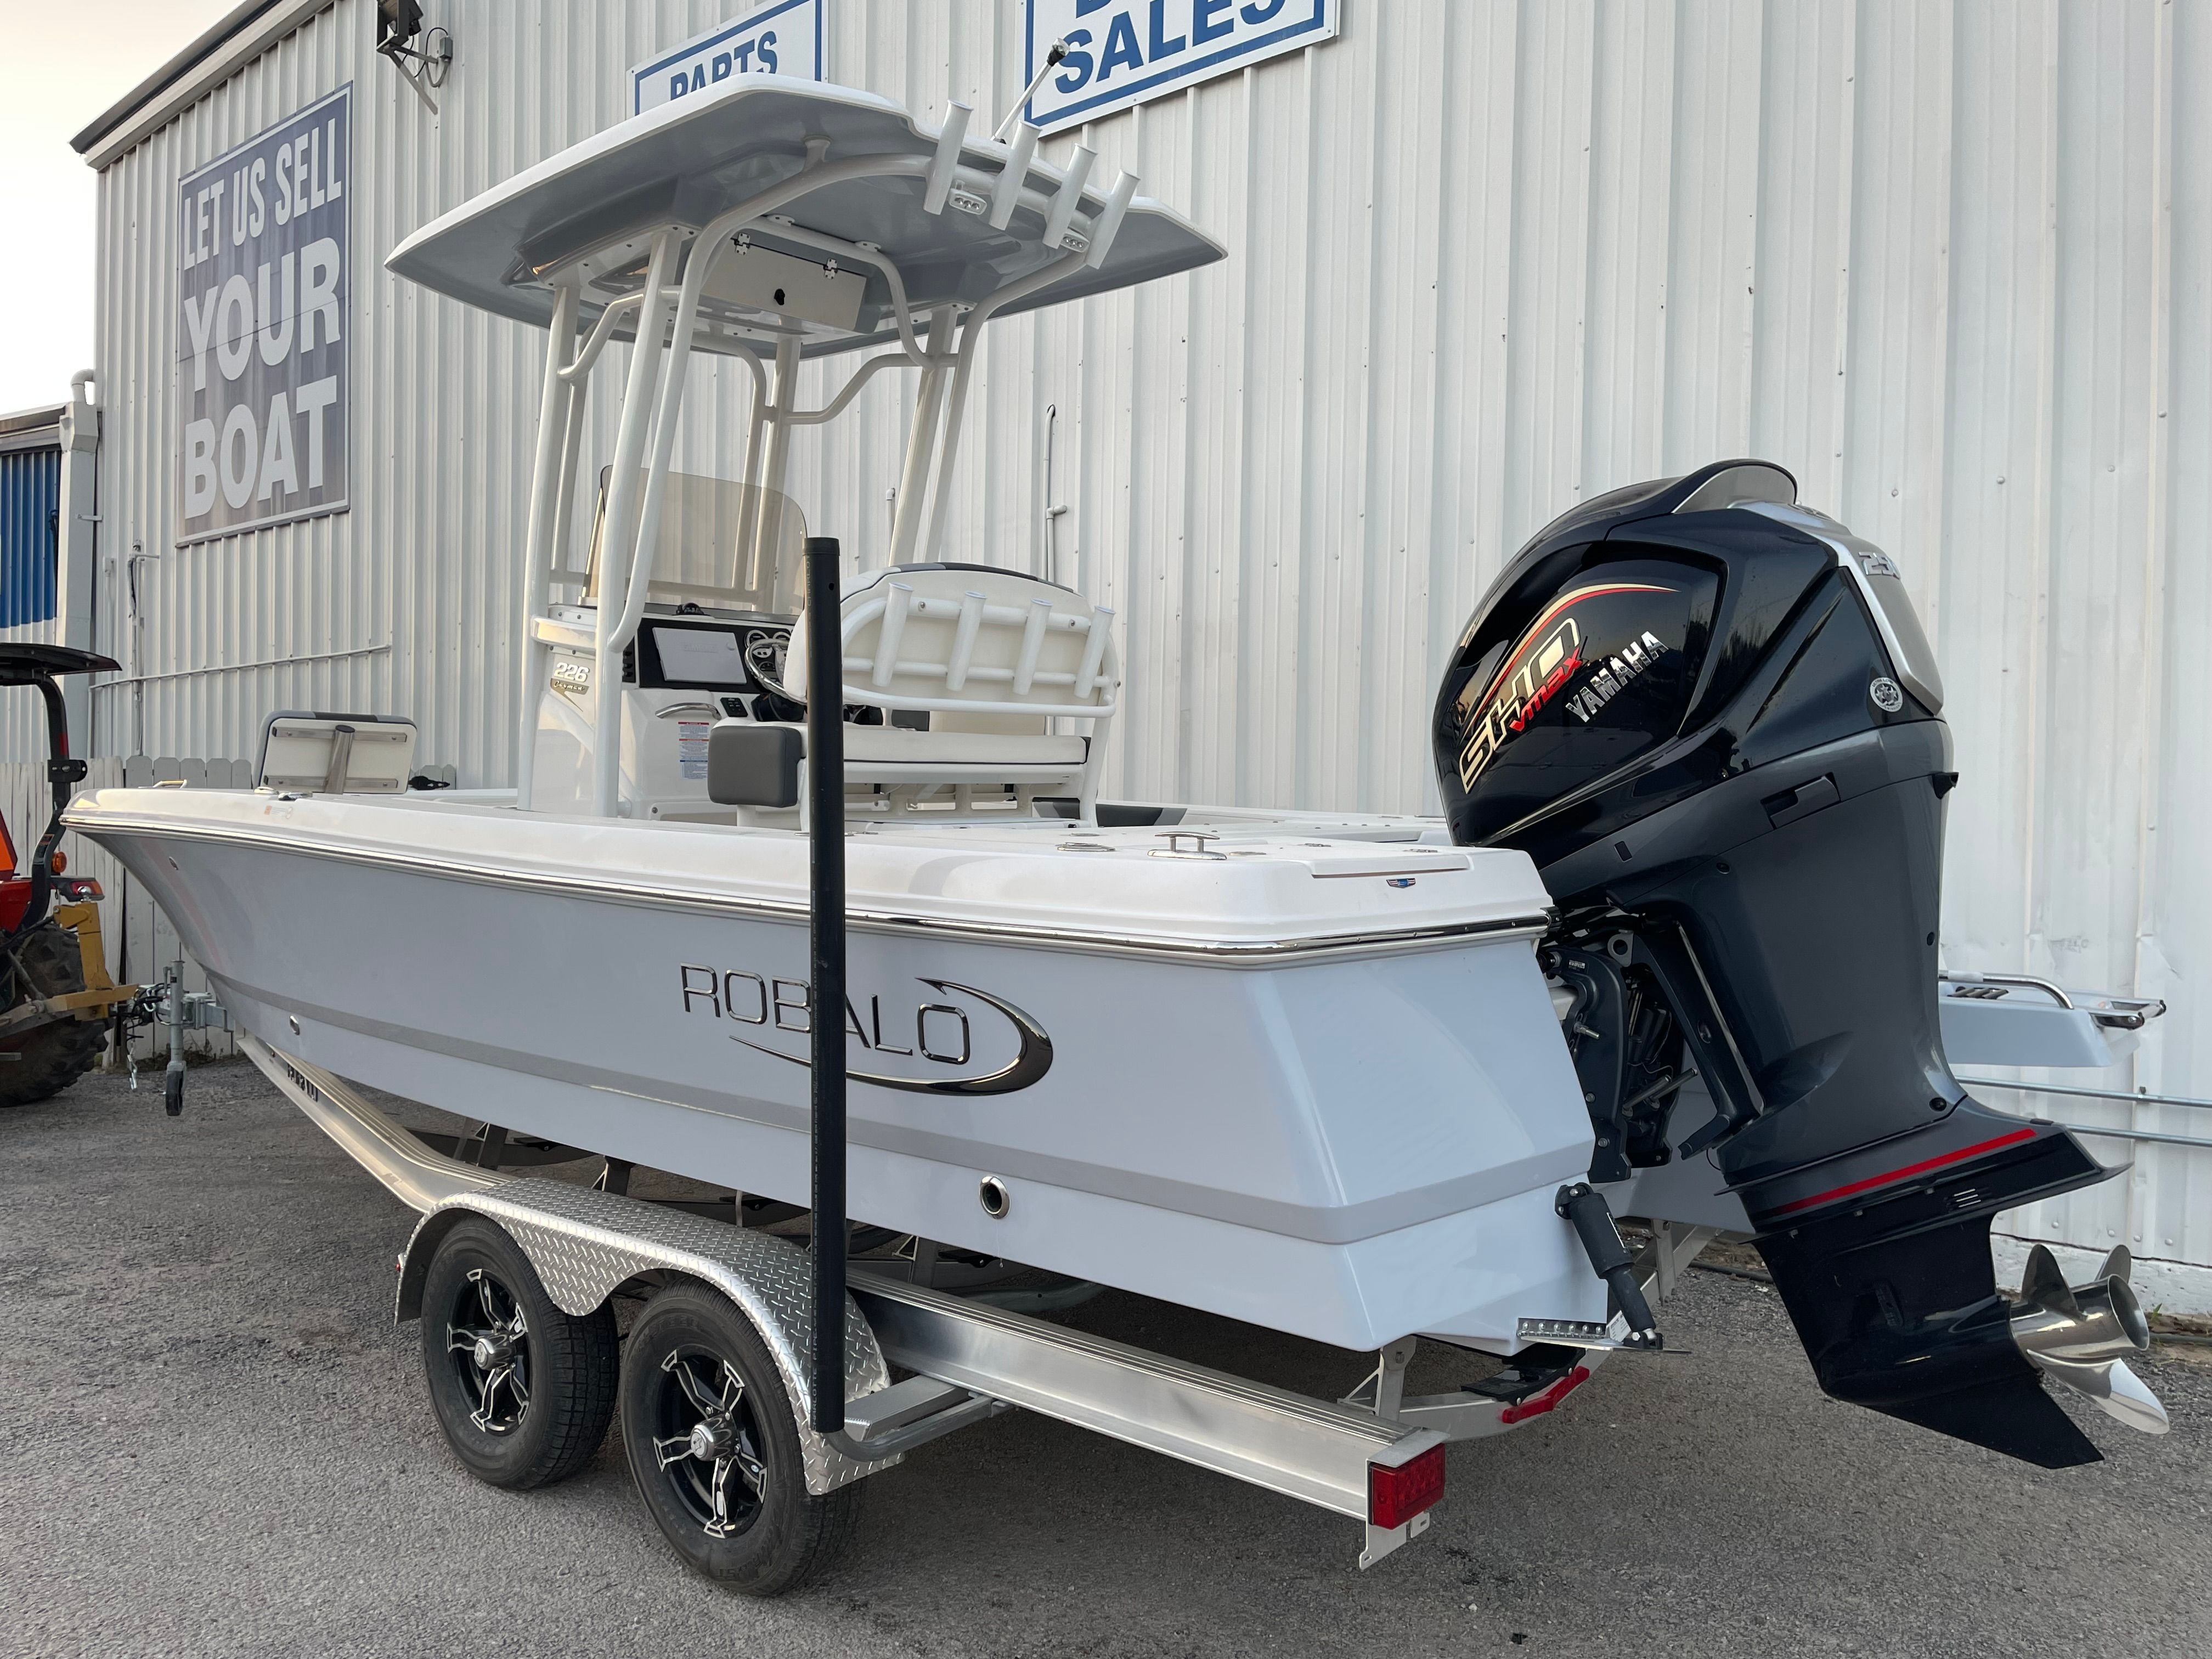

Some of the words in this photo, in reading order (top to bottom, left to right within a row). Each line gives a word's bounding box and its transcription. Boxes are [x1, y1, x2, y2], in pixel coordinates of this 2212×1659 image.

[184, 179, 224, 270] LET
[232, 157, 266, 246] US
[275, 118, 342, 225] SELL
[184, 237, 341, 392] YOUR
[185, 375, 337, 519] BOAT
[554, 662, 590, 683] 226
[1565, 630, 1669, 723] YAMAHA
